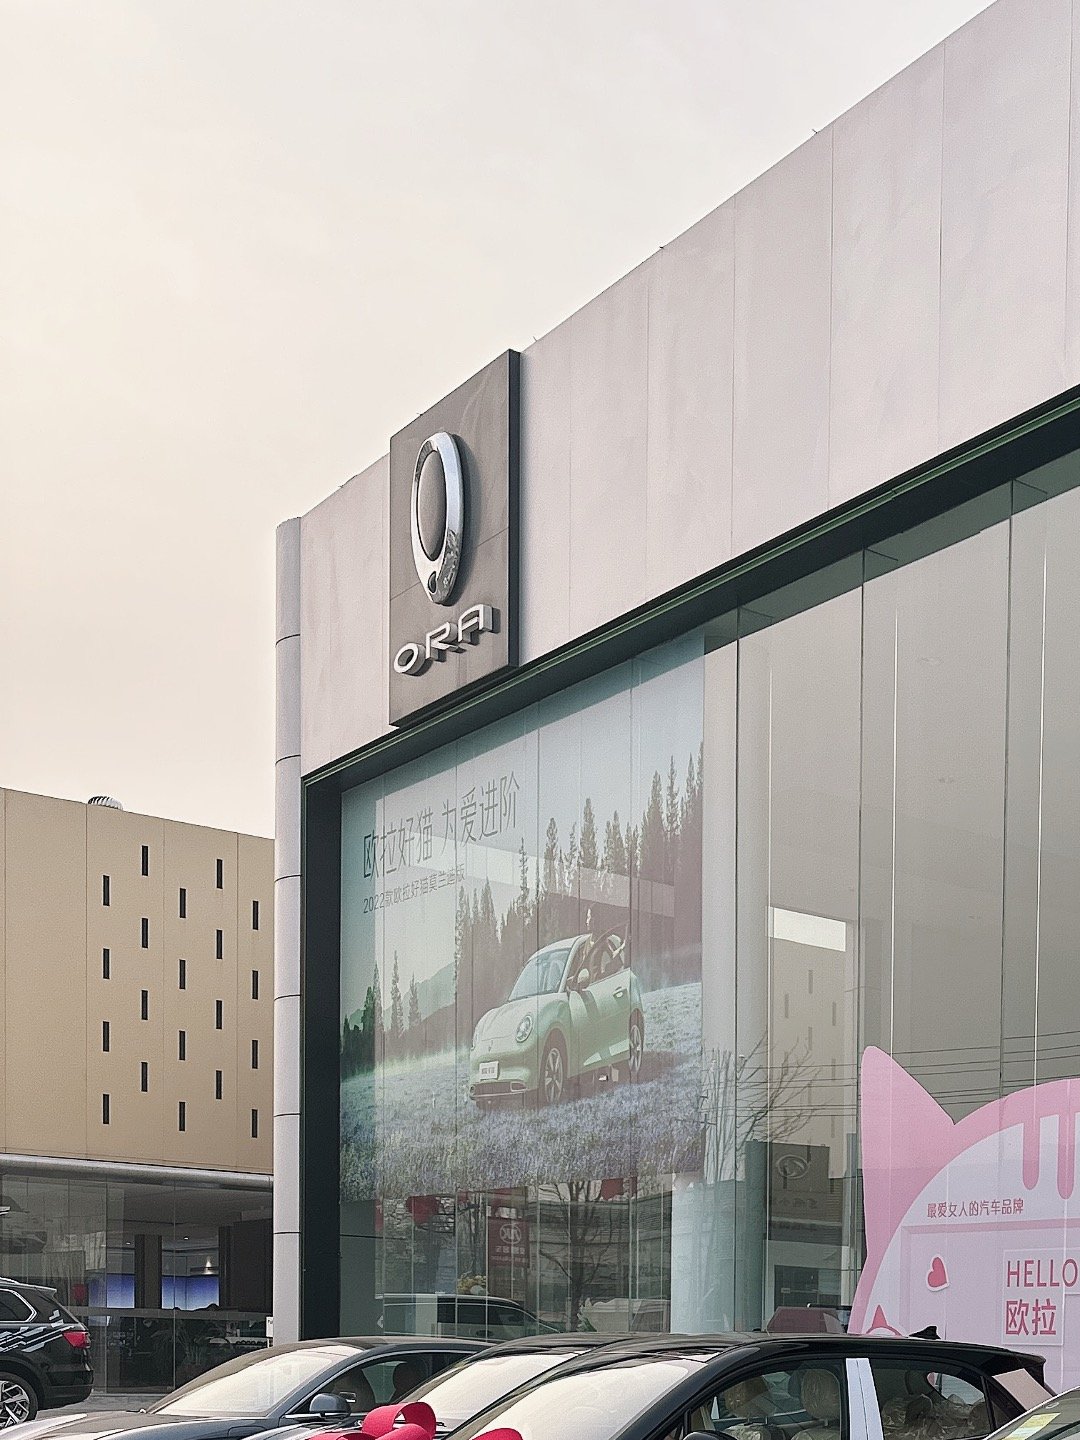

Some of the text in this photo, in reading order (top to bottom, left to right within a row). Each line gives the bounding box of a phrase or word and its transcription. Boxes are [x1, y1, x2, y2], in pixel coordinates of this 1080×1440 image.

[393, 603, 500, 677] ORA
[364, 771, 520, 881] 欧拉好猫 为爱进阶
[927, 1199, 1024, 1218] 最爱女人的汽车品牌
[1006, 1258, 1078, 1287] HELLO
[1005, 1298, 1057, 1336] 欧拉
